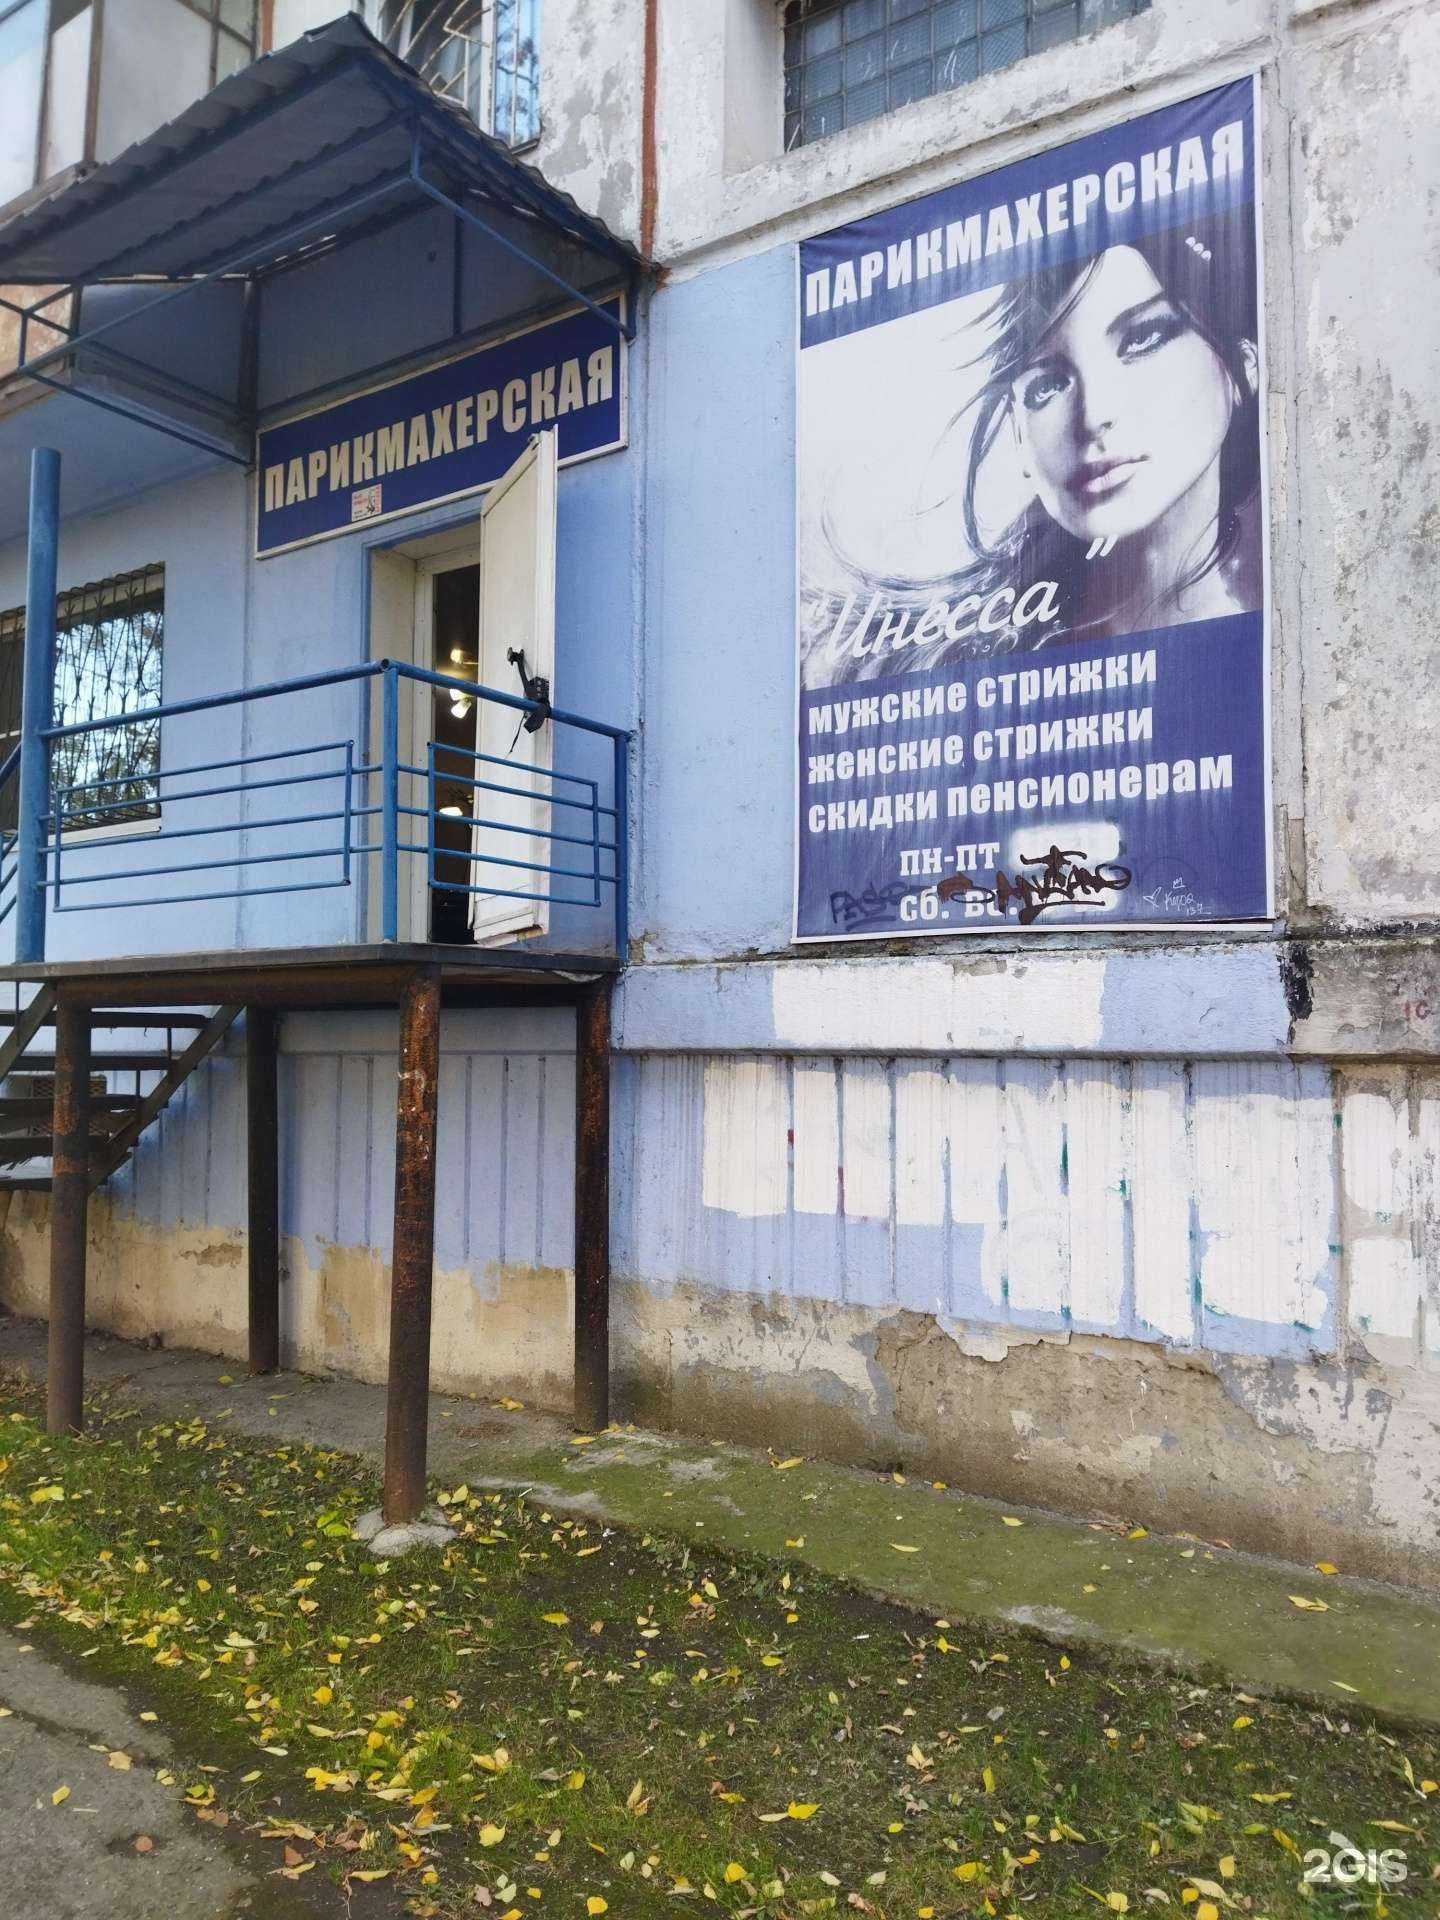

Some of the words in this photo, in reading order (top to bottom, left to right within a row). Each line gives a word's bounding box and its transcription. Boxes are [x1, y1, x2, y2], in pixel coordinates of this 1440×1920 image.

[805, 120, 1244, 317] ПАРИКМАХЕРСКАЯ
[264, 345, 613, 512] ПАРИКМАХЕРСКАЯ
[808, 681, 967, 735] мужские
[976, 649, 1157, 707] стрижки
[808, 734, 963, 785] женские
[973, 706, 1153, 760] стрижки
[808, 787, 938, 834] скидки
[947, 754, 1233, 818] пенсионерам
